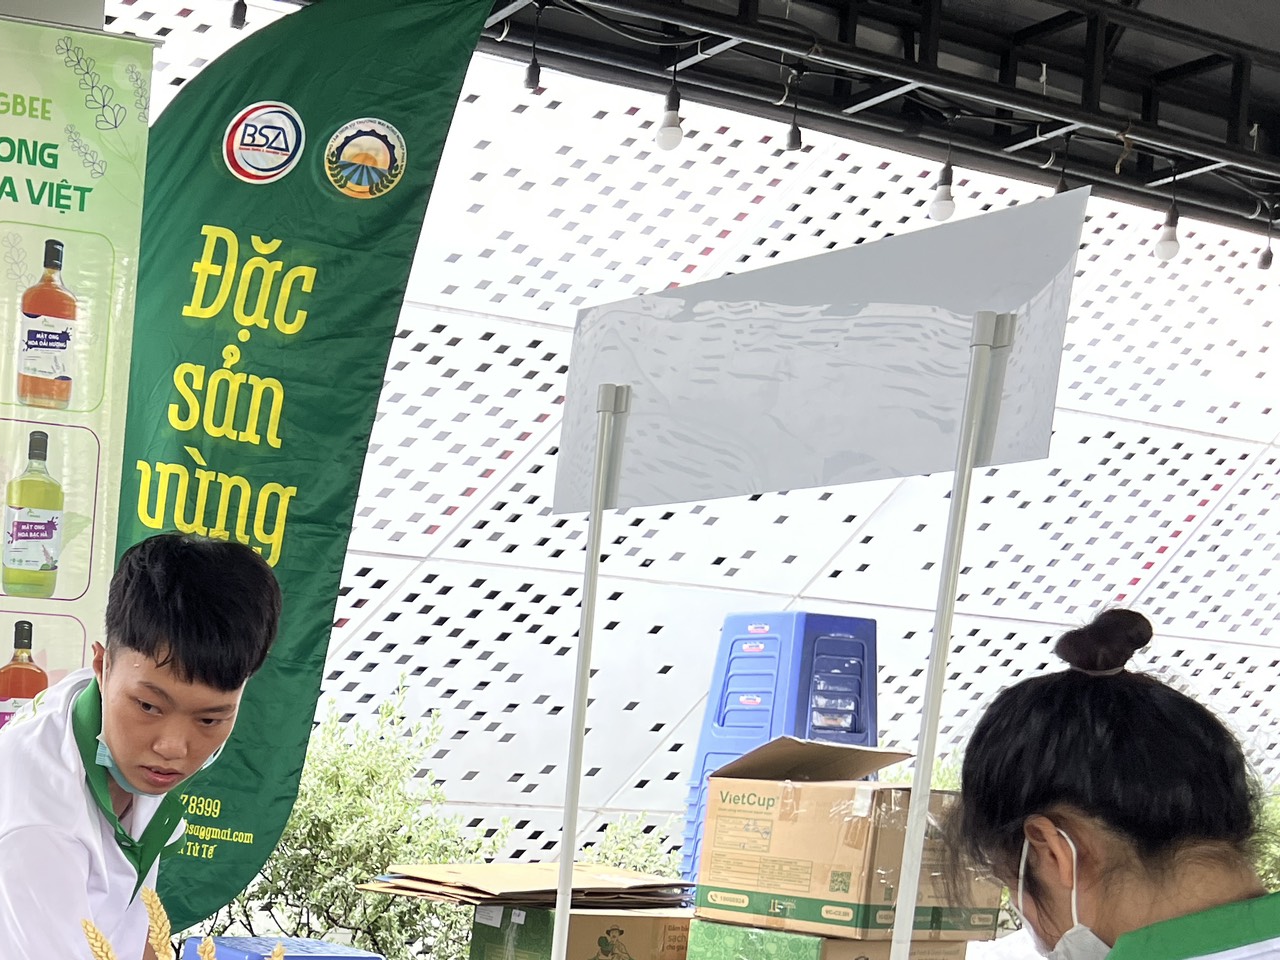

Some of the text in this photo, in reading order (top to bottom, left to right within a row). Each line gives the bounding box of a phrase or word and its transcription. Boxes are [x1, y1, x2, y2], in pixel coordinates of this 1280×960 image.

[240, 123, 290, 153] BSA
[25, 178, 93, 214] VIỆT
[182, 224, 317, 342] Đặc
[168, 344, 284, 449] sản
[136, 445, 297, 568] vùng
[719, 790, 776, 810] VietCup
